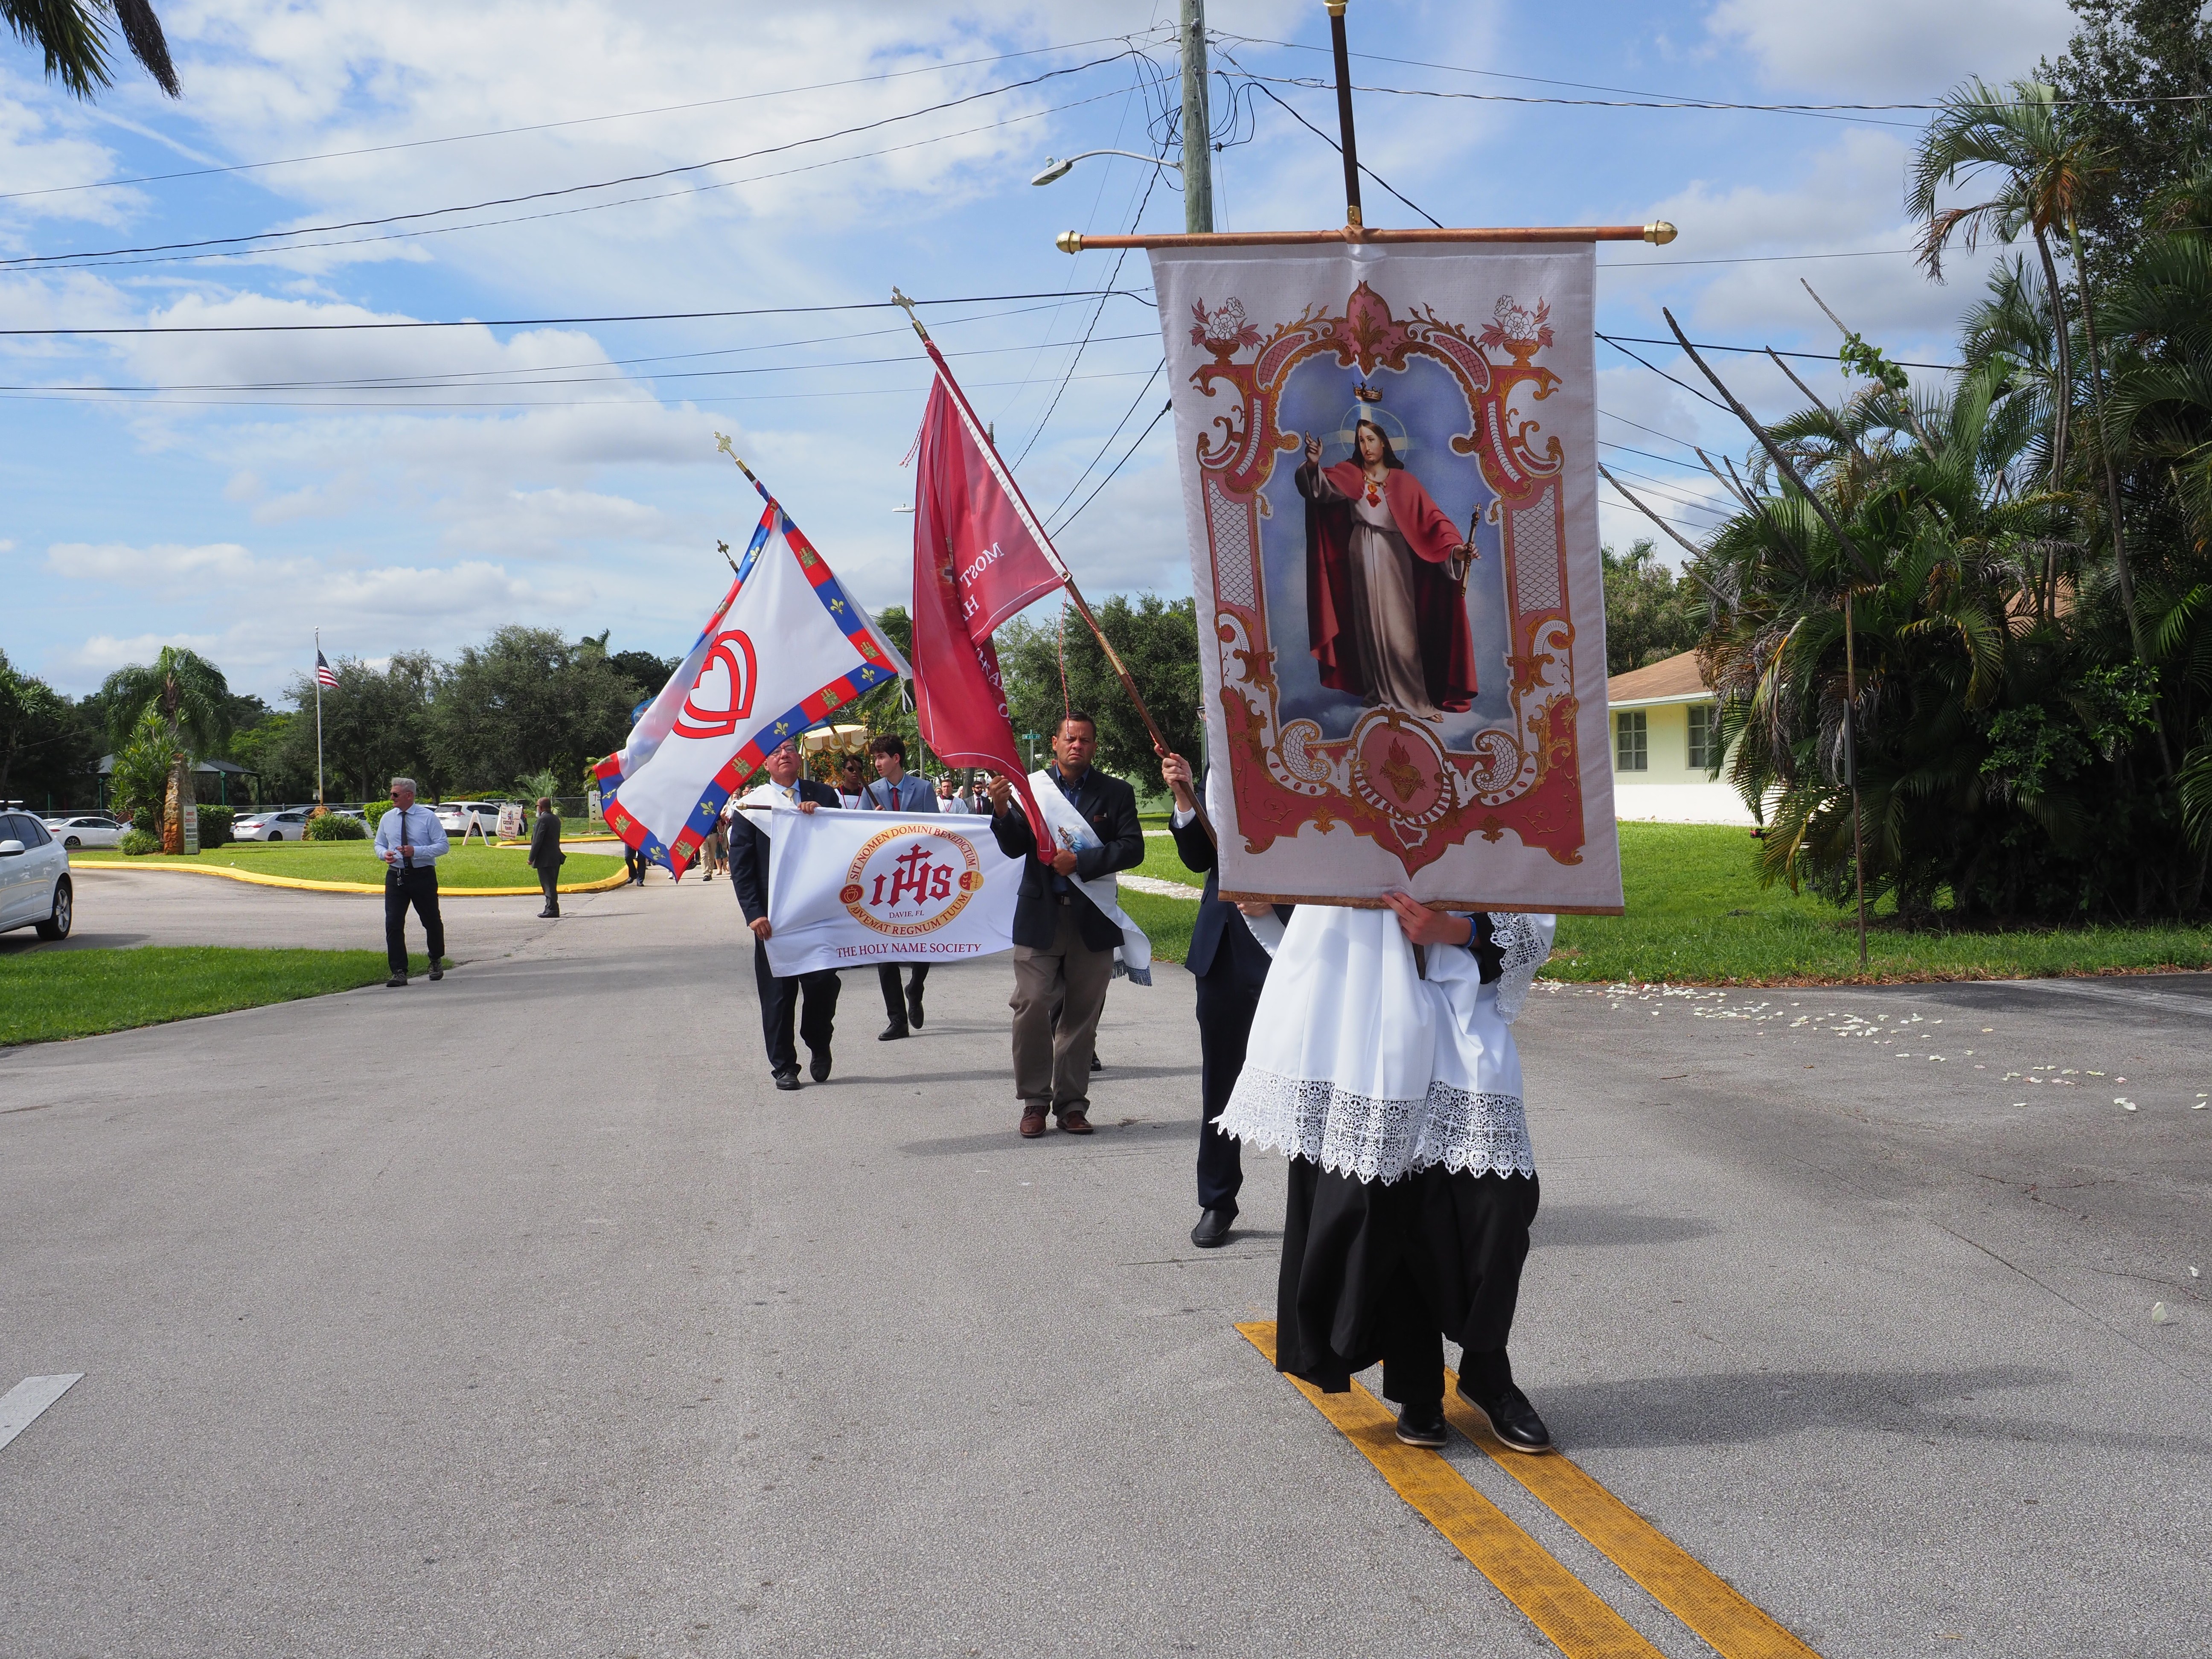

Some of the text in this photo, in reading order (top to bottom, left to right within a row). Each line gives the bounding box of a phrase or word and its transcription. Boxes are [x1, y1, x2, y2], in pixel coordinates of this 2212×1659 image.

[850, 826, 976, 880] SIT NOMEN DOMINI BENEDICTUM
[850, 894, 969, 934] ADVENIAT REGNUM TUUM
[836, 943, 982, 958] THE HOLY NAME SOCIETY
